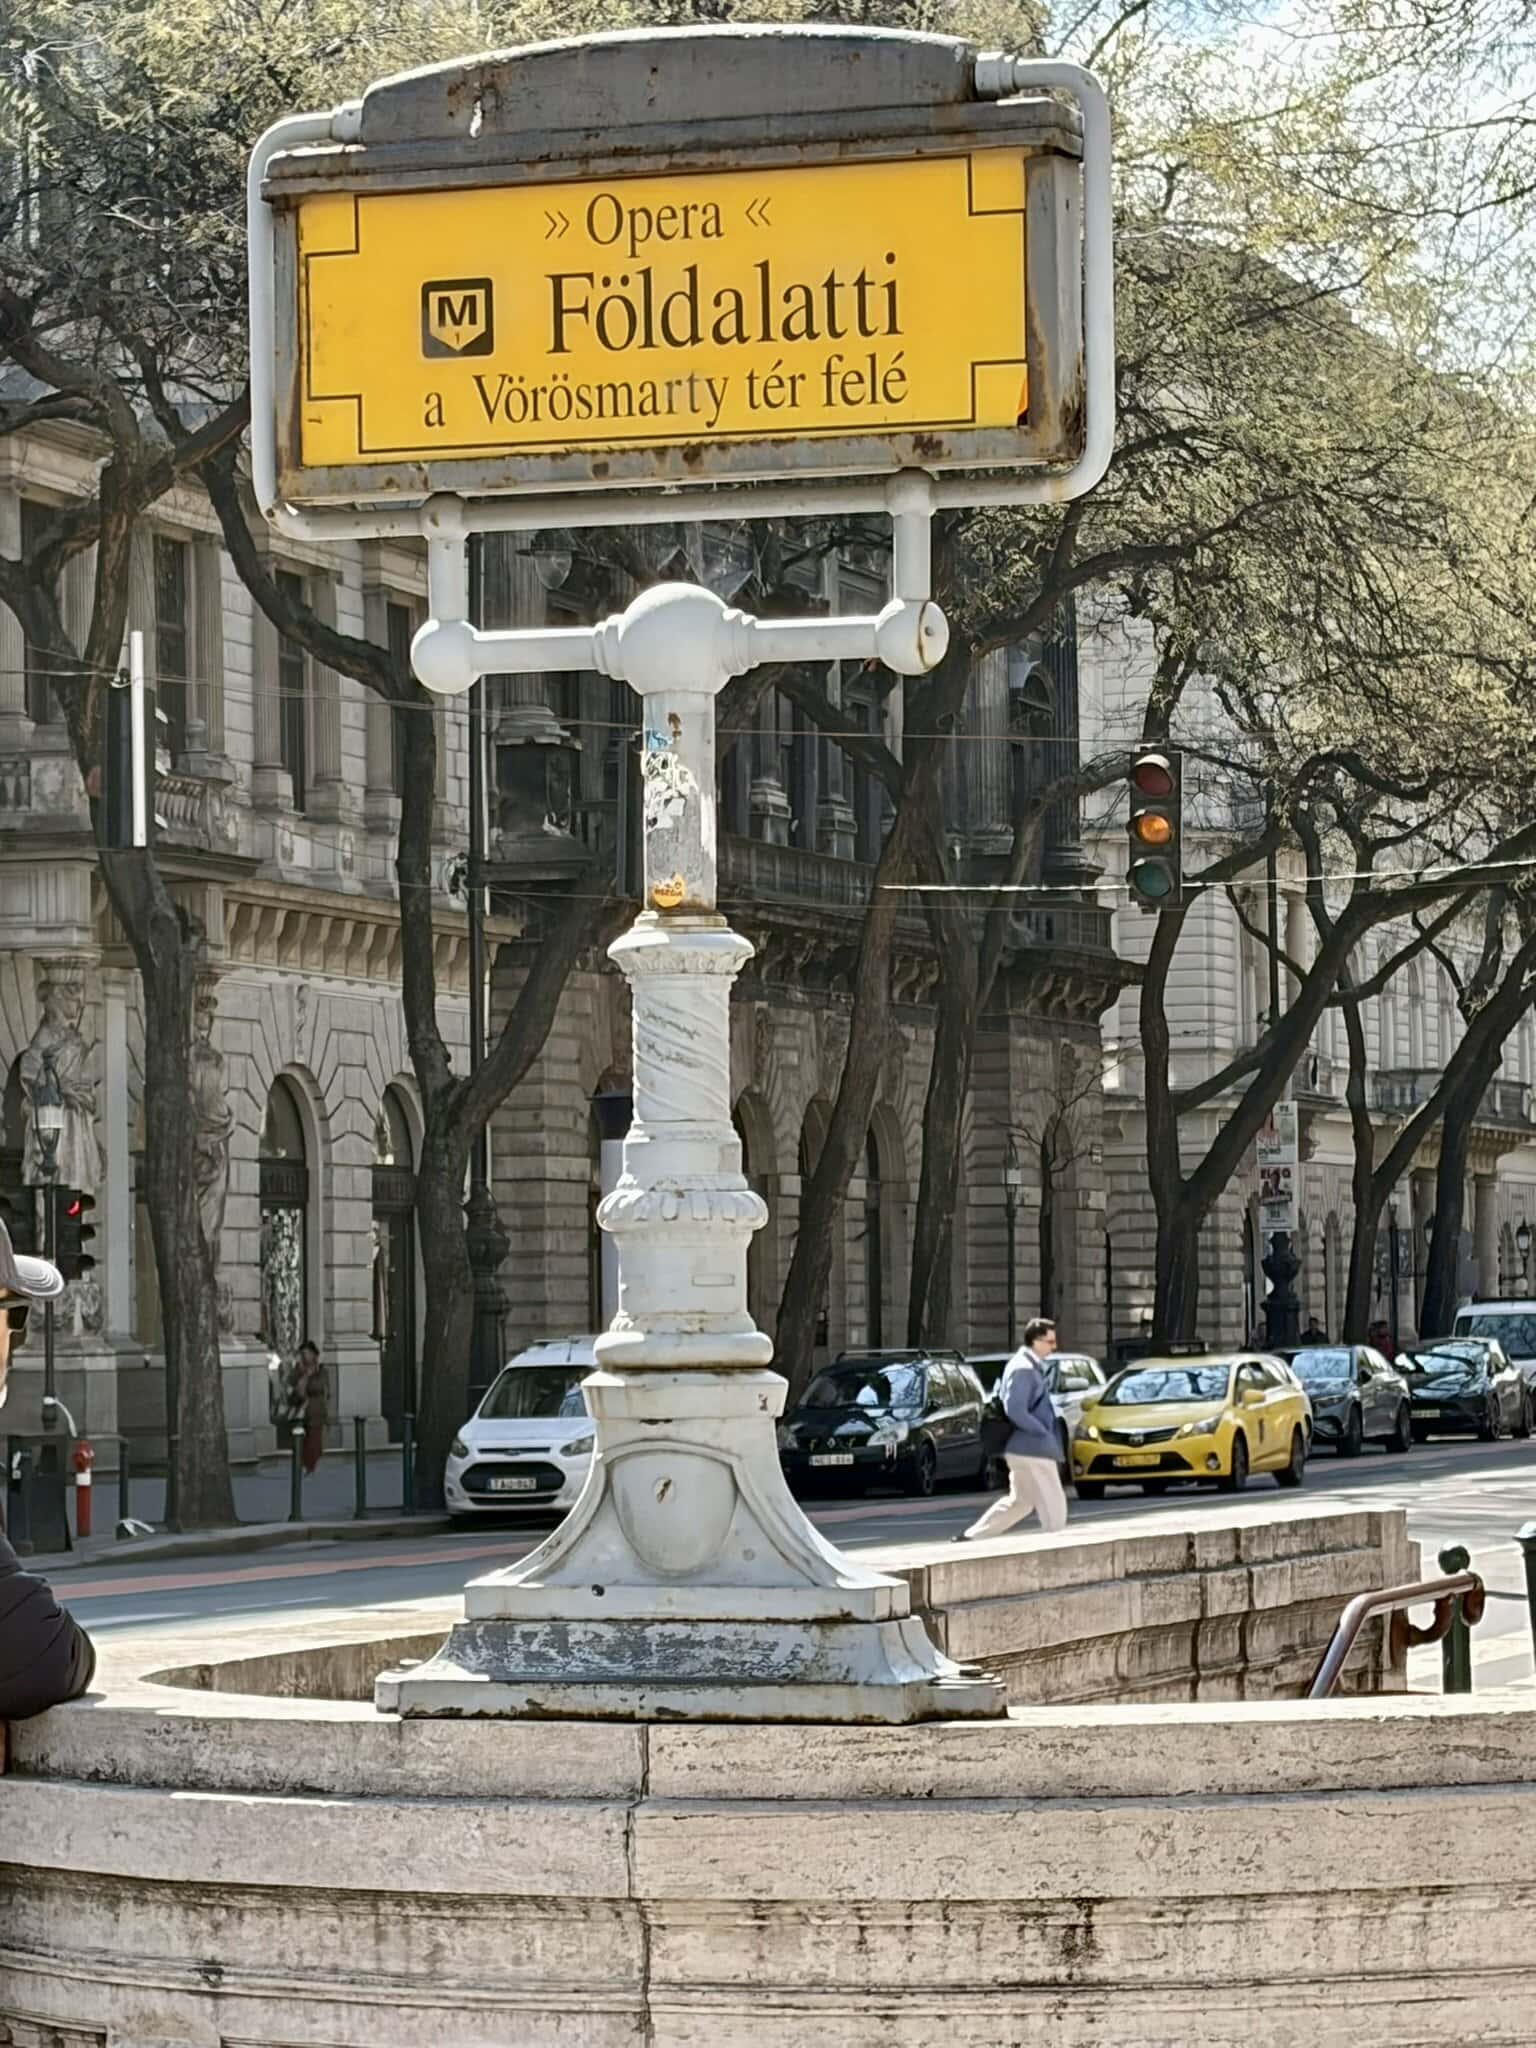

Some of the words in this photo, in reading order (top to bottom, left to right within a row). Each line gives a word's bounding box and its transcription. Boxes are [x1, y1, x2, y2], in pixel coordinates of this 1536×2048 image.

[586, 193, 724, 259] Opera
[437, 294, 478, 329] M
[545, 251, 905, 355] Földalatti
[424, 392, 446, 428] a
[472, 372, 728, 429] Vörösmarty
[746, 360, 807, 412] tér
[821, 352, 907, 407] felé
